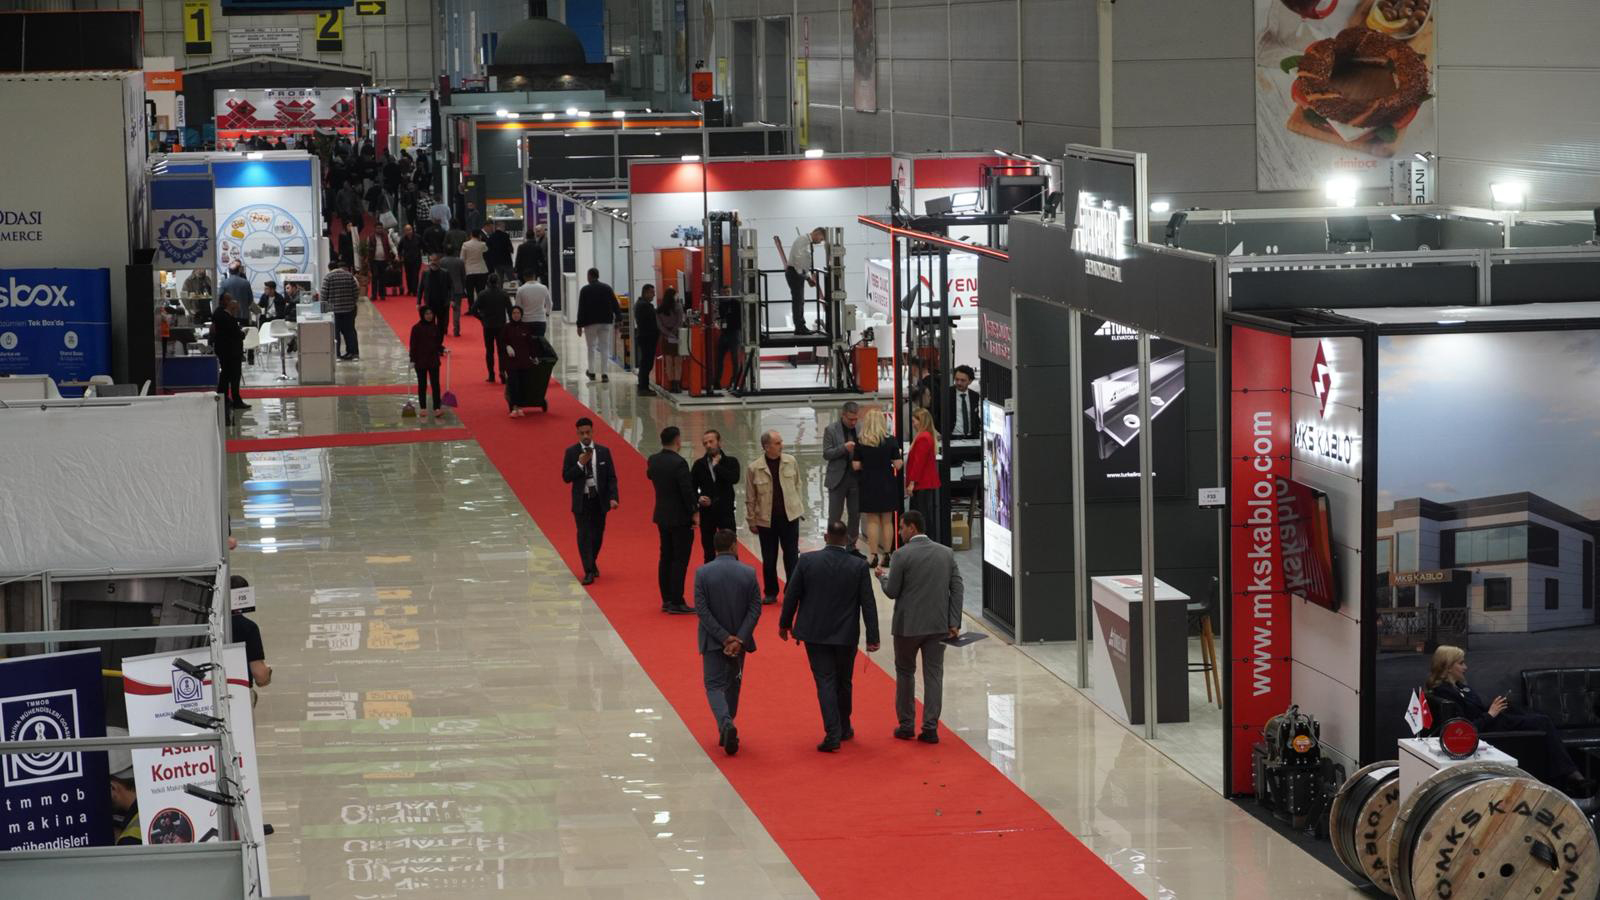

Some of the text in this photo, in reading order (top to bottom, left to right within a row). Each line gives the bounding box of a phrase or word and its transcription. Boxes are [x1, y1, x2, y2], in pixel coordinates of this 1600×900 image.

[190, 8, 206, 41] 1
[318, 9, 340, 39] 2
[28, 319, 41, 327] Tek
[1294, 421, 1351, 464] MKS KABLO
[1247, 410, 1273, 697] www.mkskablo.com
[1413, 571, 1444, 581] KABLO
[107, 582, 116, 594] 5
[26, 698, 50, 707] TMMOB
[6, 787, 86, 811] tmmob
[8, 812, 88, 834] makina
[10, 832, 89, 851] mühendisleri
